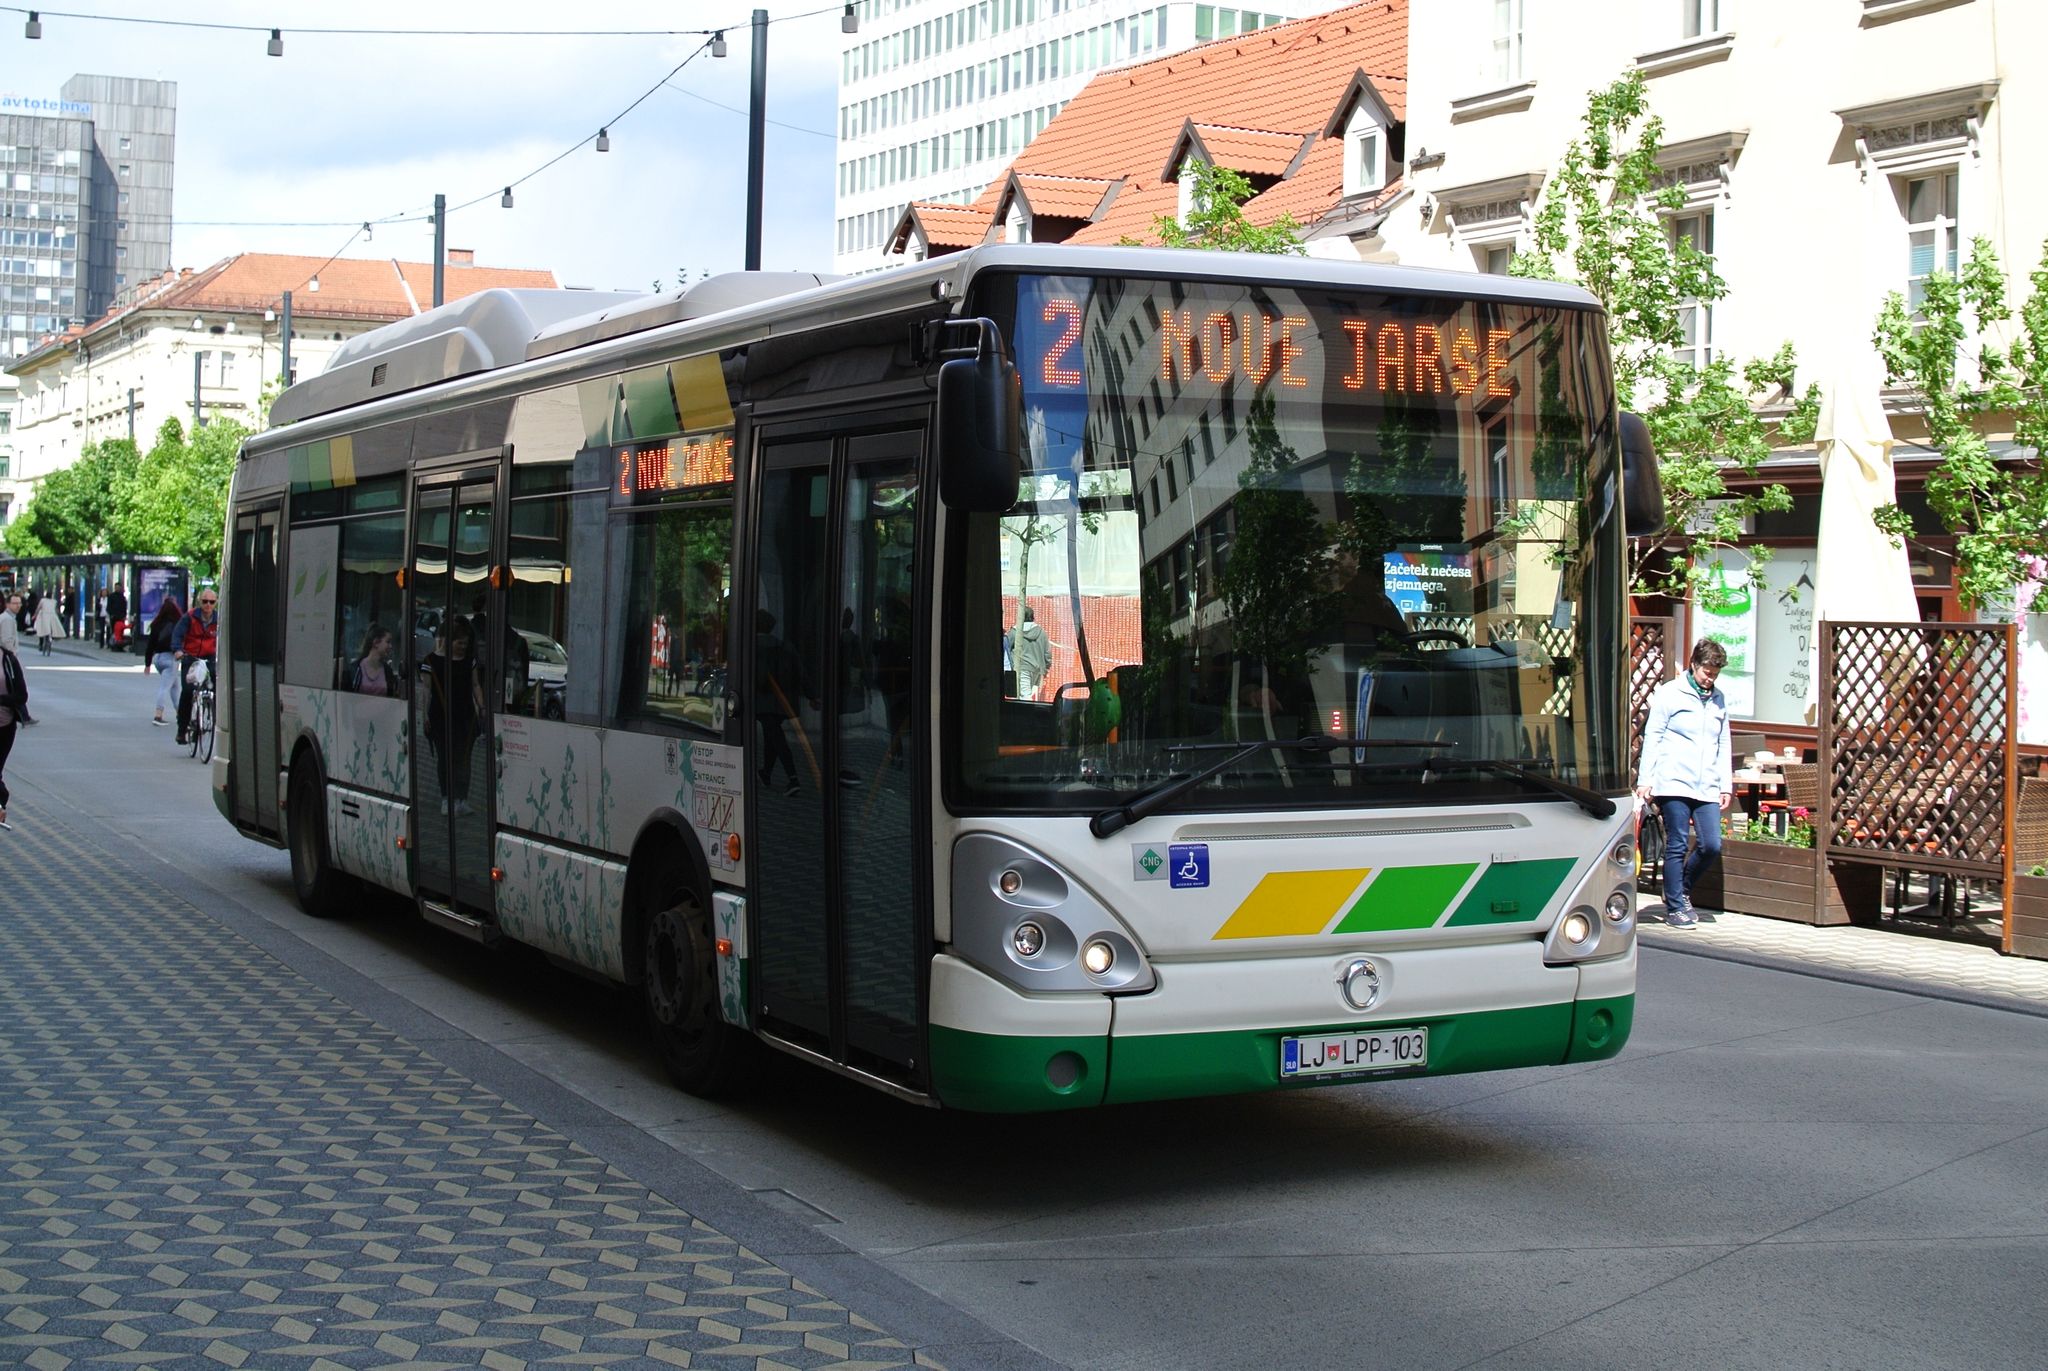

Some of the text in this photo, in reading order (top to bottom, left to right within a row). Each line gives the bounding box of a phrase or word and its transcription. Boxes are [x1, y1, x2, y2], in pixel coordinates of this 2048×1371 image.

[2, 96, 90, 113] avtotehna
[1043, 298, 1512, 397] 2 NOVE JARŠE
[620, 439, 734, 496] 2 NOVE JARŠE
[1384, 562, 1472, 578] Začetek nečesa
[1384, 578, 1447, 593] izjemnega.
[1142, 857, 1160, 867] CNG
[1300, 1034, 1424, 1068] LJ LPP-103
[1285, 1061, 1297, 1070] SLO
